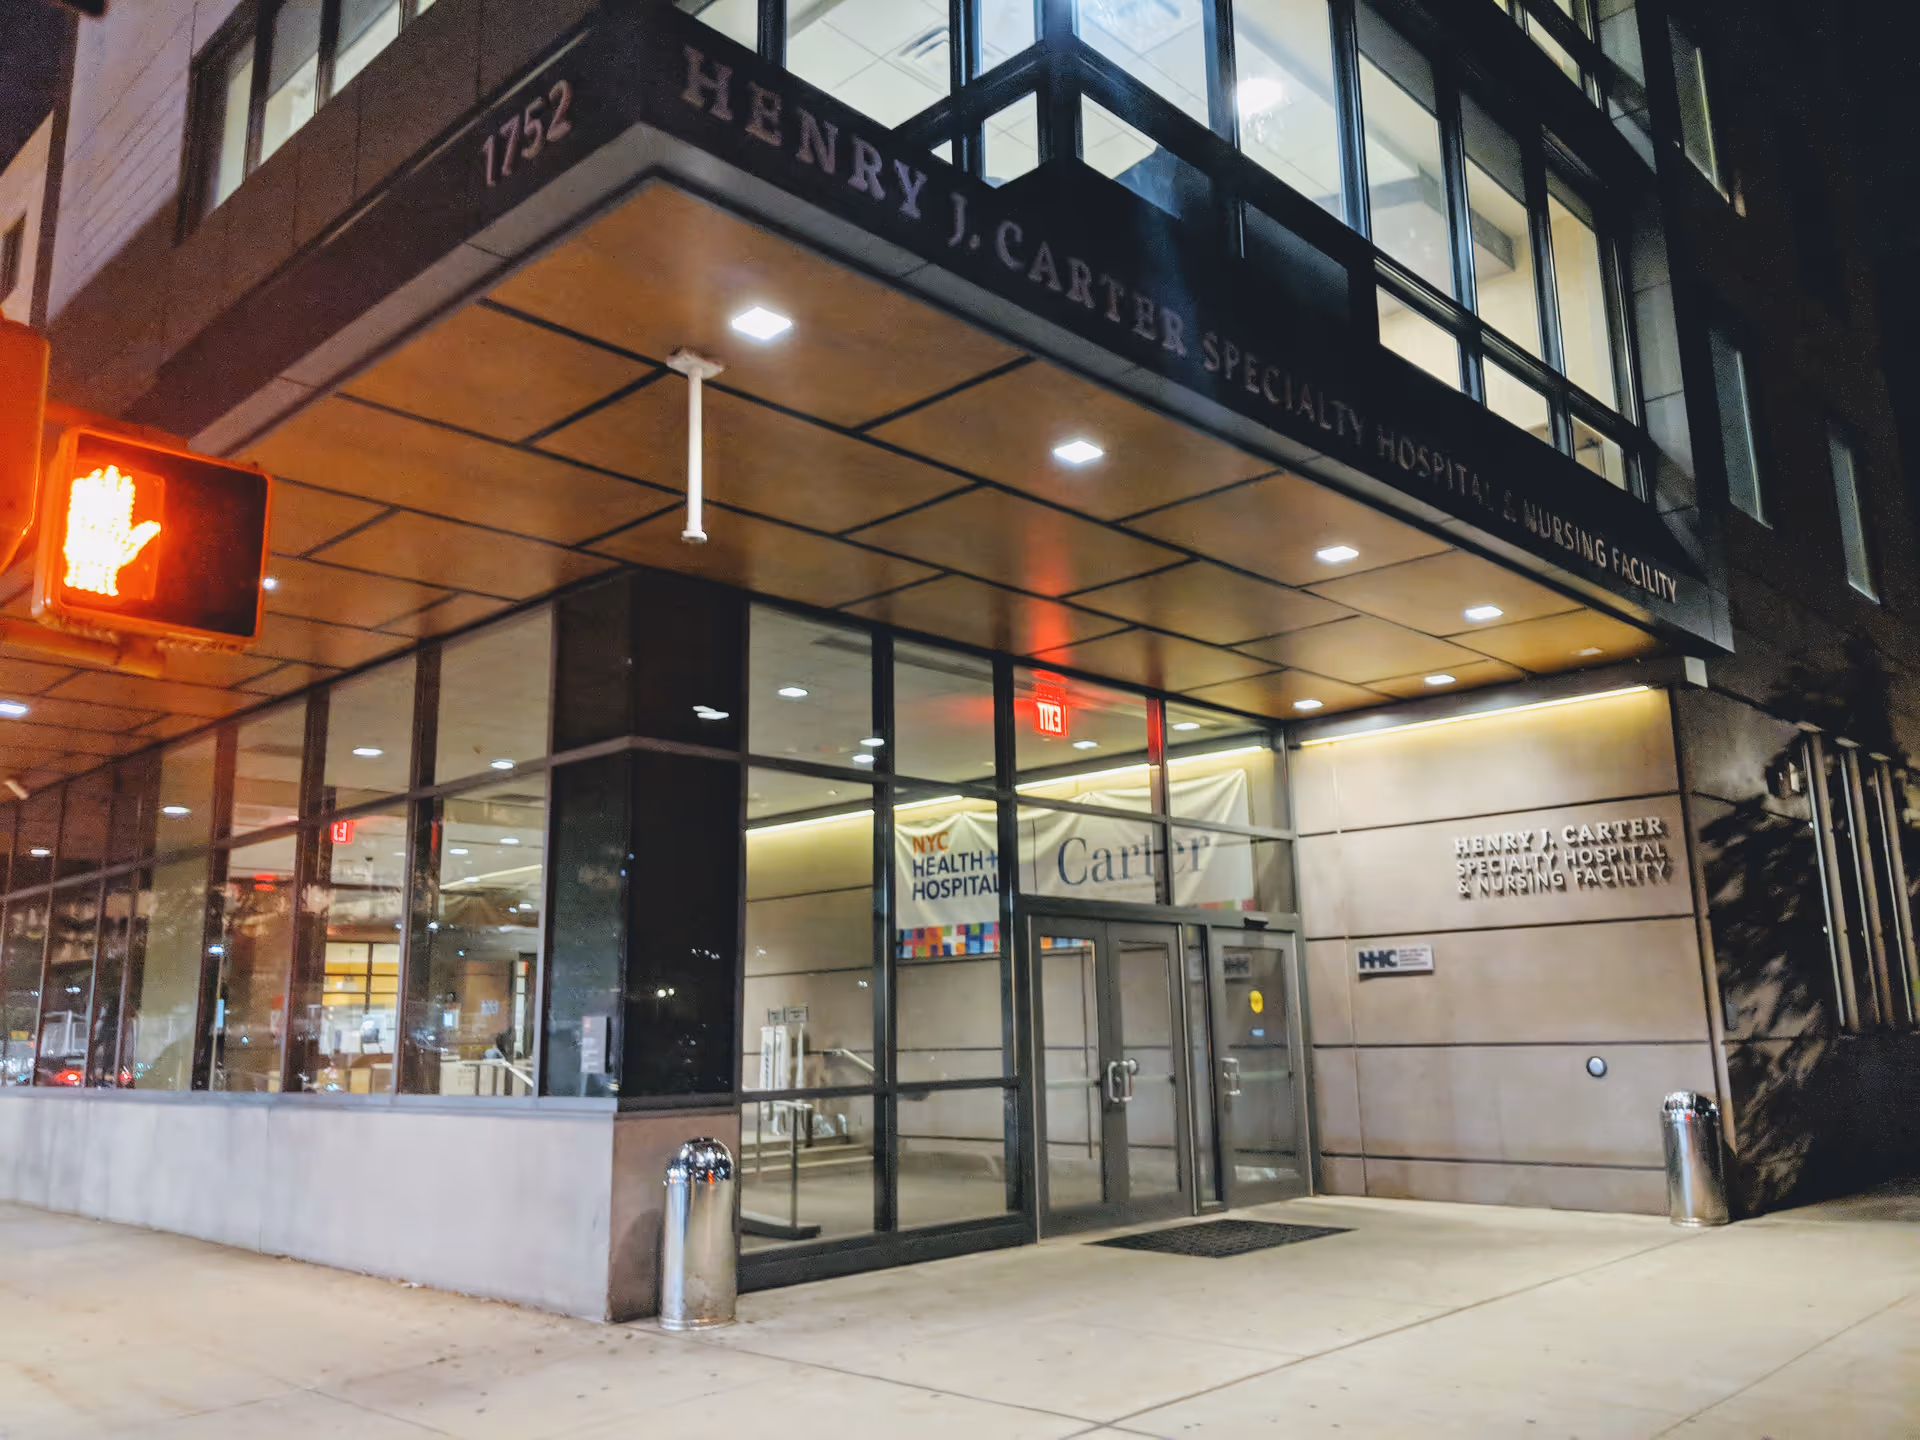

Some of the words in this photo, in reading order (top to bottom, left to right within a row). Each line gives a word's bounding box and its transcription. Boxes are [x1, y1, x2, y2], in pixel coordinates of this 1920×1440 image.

[482, 79, 573, 188] 1752
[682, 44, 929, 220] HENRY
[948, 191, 982, 251] J.
[994, 220, 1188, 357] CARTER
[1203, 330, 1367, 446] SPECIALTY
[1377, 423, 1494, 513] HOSPITAL
[1523, 497, 1608, 569] NURSING
[1612, 546, 1678, 604] FACILITY
[912, 831, 949, 854] NYC
[1454, 829, 1533, 854] HENRY
[1539, 827, 1556, 850] J.
[1561, 816, 1664, 844] CARTER
[1456, 852, 1556, 877] SPECIALTY
[1563, 841, 1666, 867] HOSPITAL
[1457, 880, 1471, 894] &
[1477, 870, 1565, 892] NURSING
[1574, 861, 1667, 885] FACILITY
[1358, 948, 1398, 969] HHC
